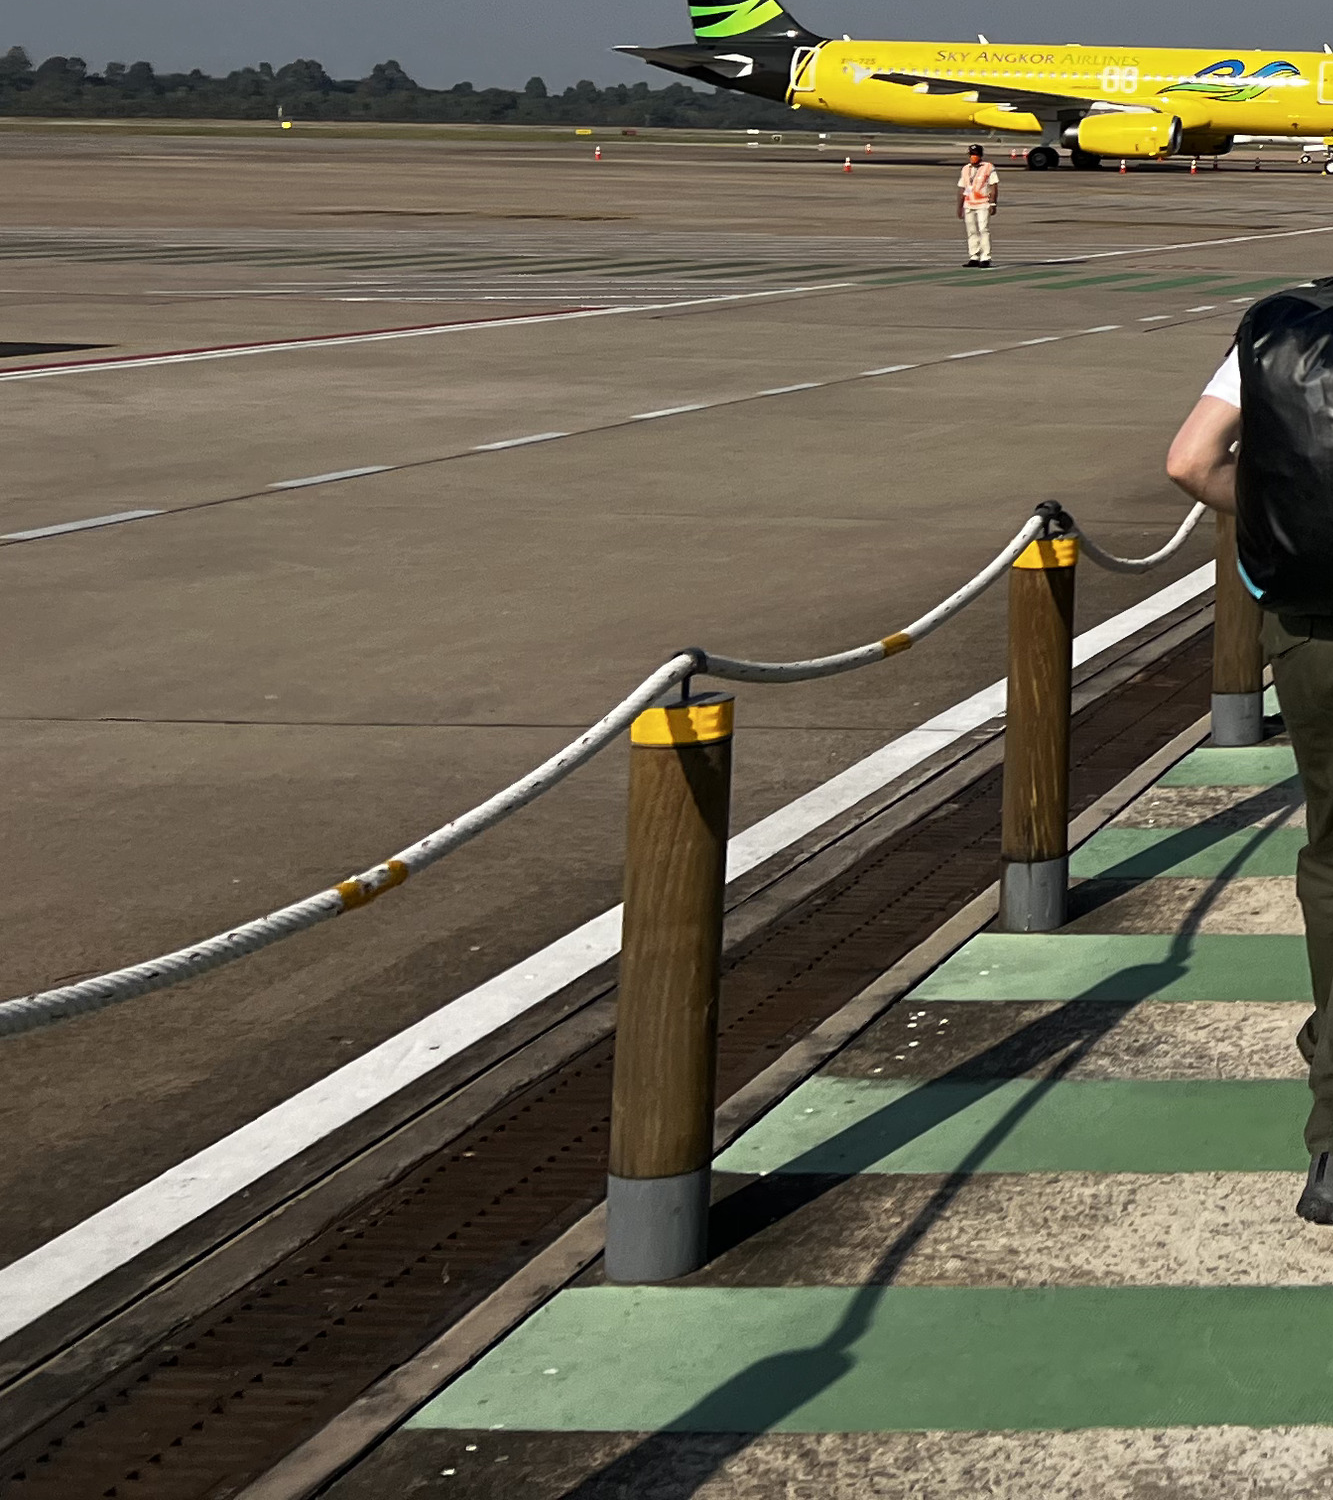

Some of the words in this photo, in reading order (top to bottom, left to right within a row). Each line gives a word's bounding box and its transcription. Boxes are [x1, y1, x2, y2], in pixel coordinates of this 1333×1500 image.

[935, 50, 971, 61] SKY
[974, 51, 1056, 64] ANGKOR
[1060, 53, 1141, 66] AIRLINES
